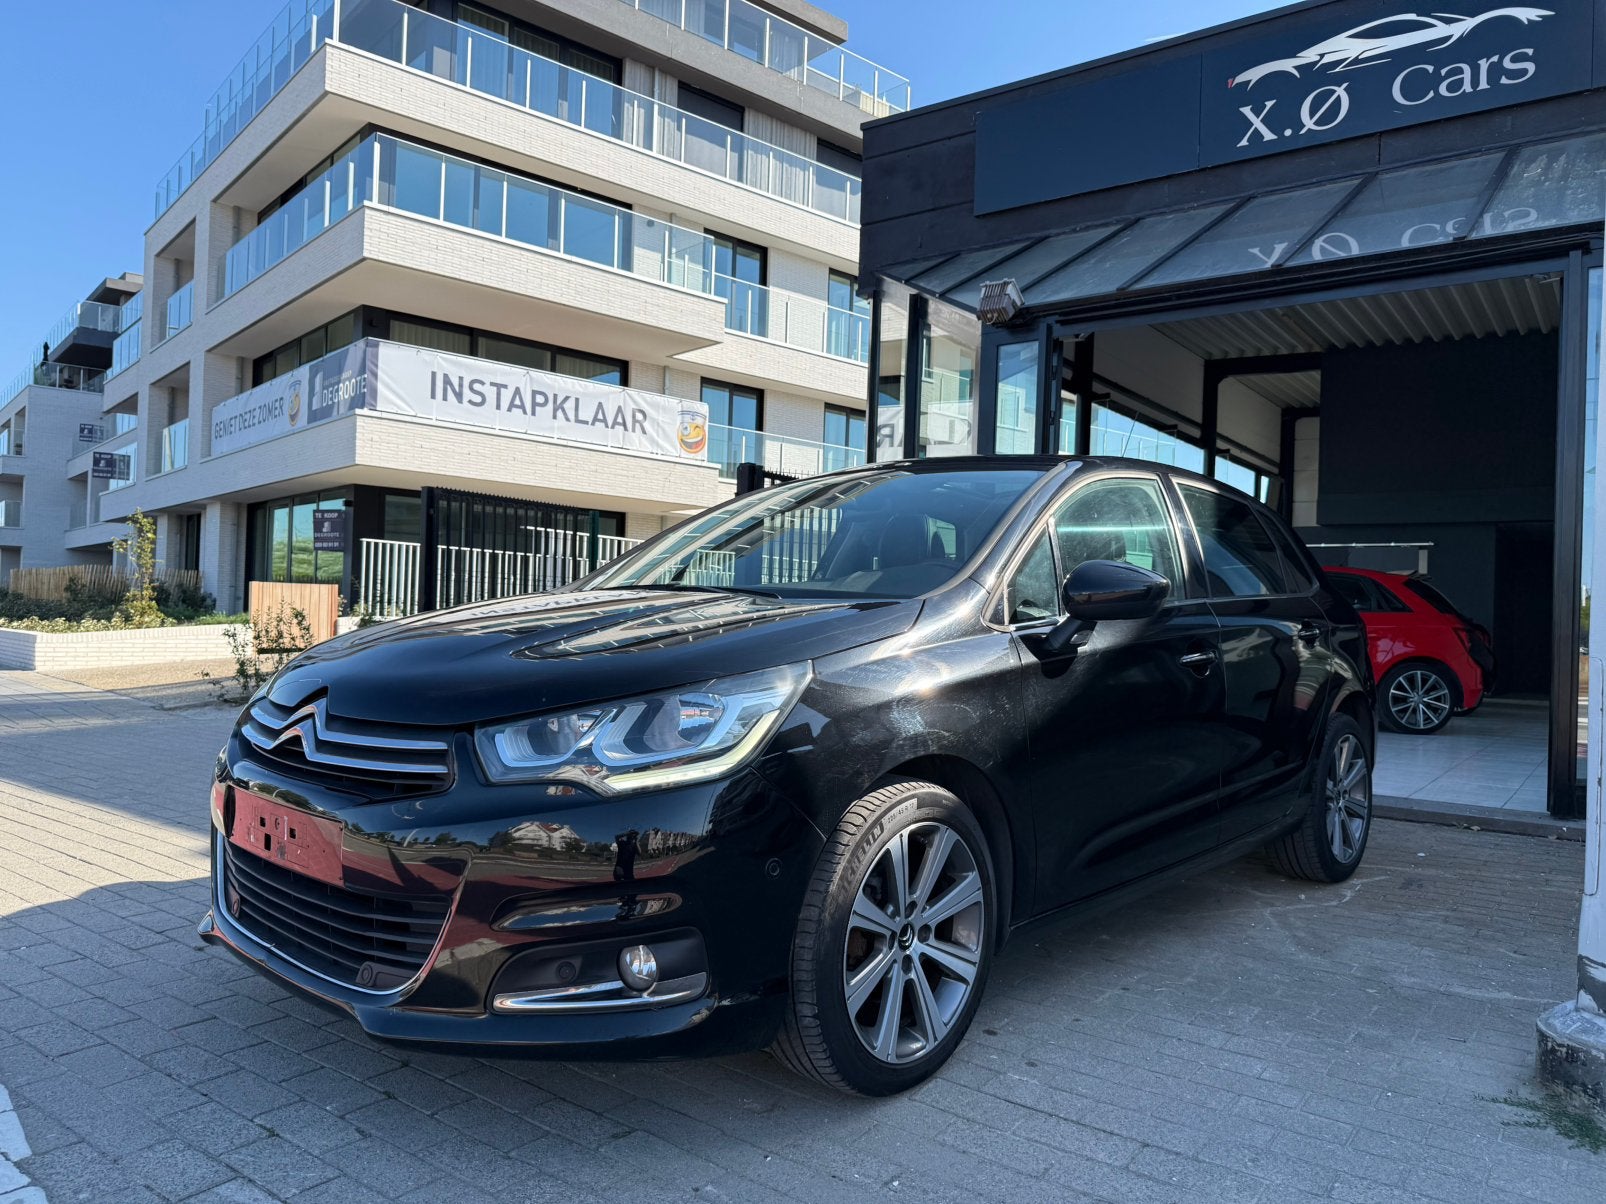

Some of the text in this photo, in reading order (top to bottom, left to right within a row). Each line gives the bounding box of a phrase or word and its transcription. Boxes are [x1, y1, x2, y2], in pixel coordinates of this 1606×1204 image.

[1392, 47, 1536, 106] Cars
[322, 373, 368, 407] DEGROOTE
[430, 371, 648, 435] INSTAPKLAAR
[214, 396, 284, 440] GENIET DEZE ZOMER
